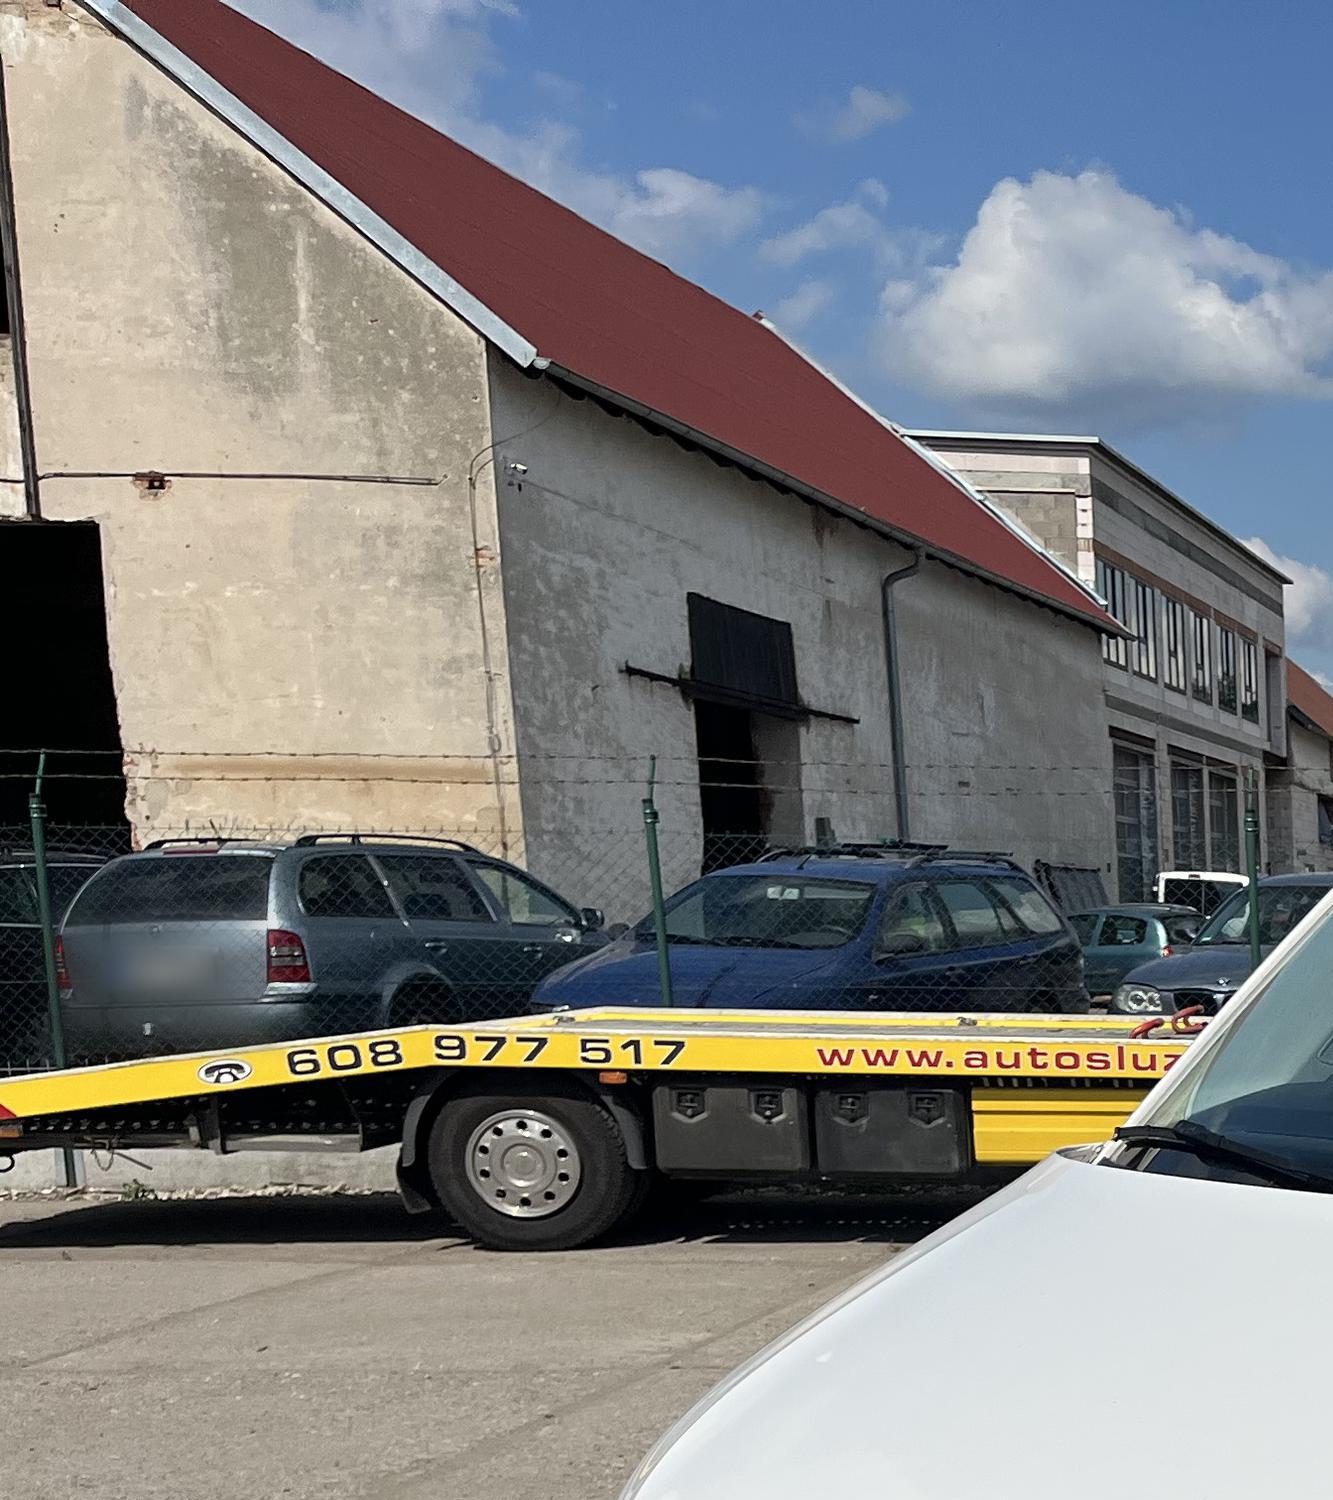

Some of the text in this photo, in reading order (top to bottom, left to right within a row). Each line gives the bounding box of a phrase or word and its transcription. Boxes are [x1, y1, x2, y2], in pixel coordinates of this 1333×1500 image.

[287, 1034, 686, 1075] 608 977 517
